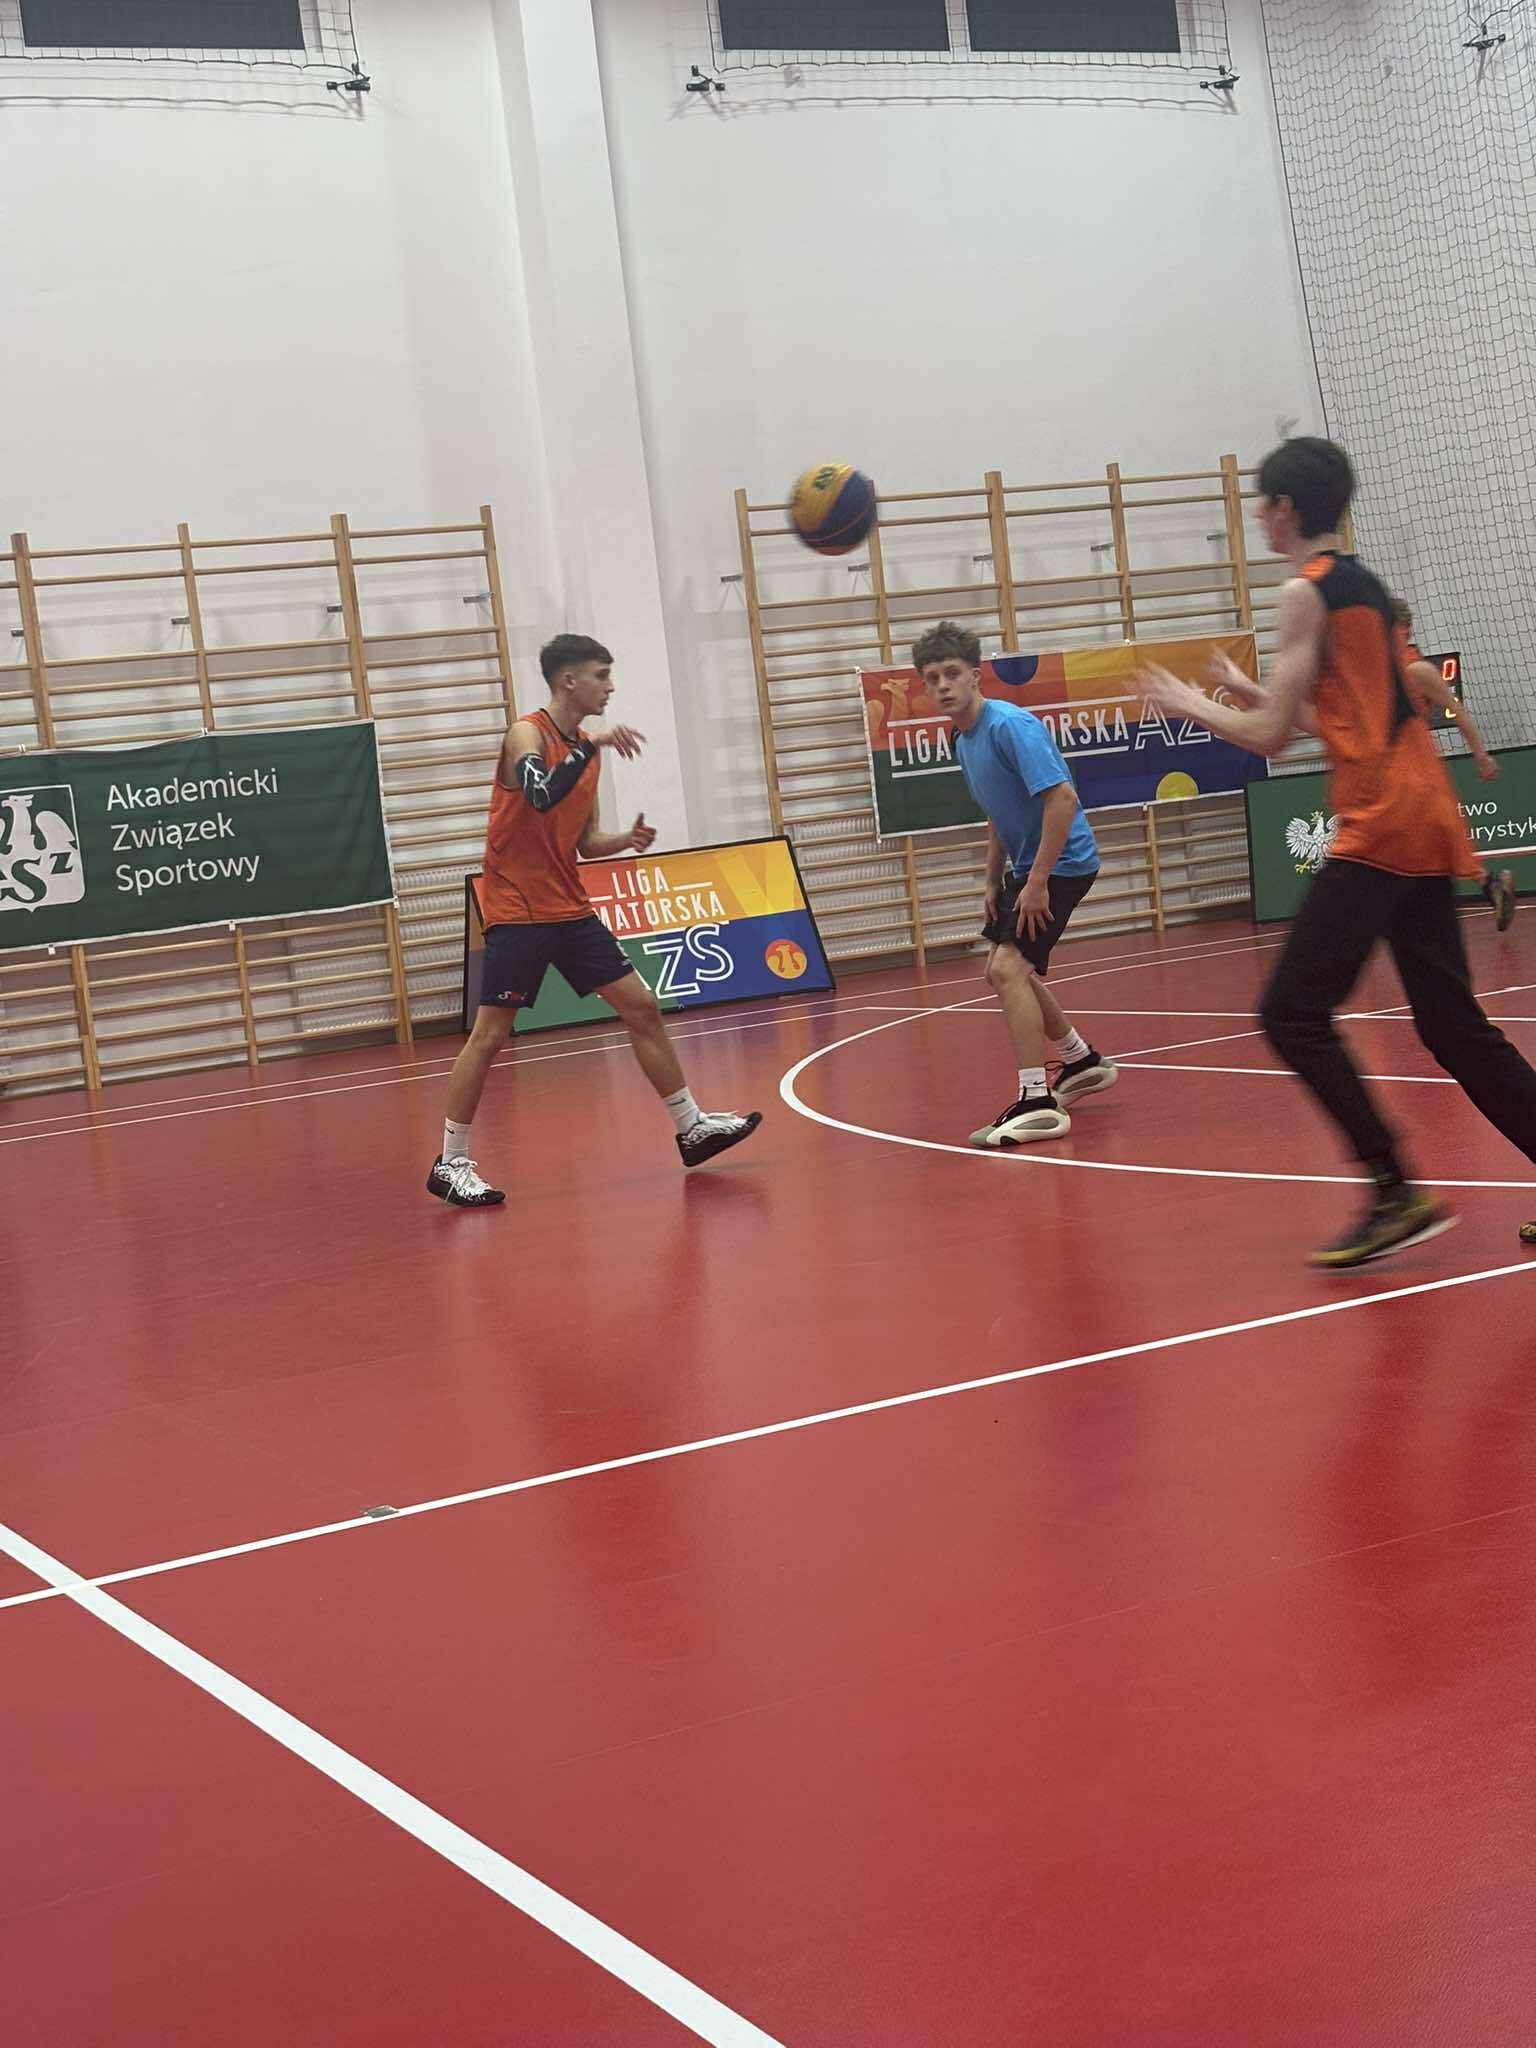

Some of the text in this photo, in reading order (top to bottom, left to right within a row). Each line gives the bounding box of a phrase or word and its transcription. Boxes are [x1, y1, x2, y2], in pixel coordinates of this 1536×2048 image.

[888, 685, 1241, 767] LIGA ORSKA AZ
[106, 767, 279, 812] Akademicki
[1457, 801, 1498, 818] two
[111, 812, 235, 851] Związek
[1466, 815, 1536, 842] urystyk
[115, 855, 261, 896] Sportowy
[611, 866, 670, 899] LIGA
[592, 890, 727, 932] MATORSKA
[632, 923, 735, 999] ZS
